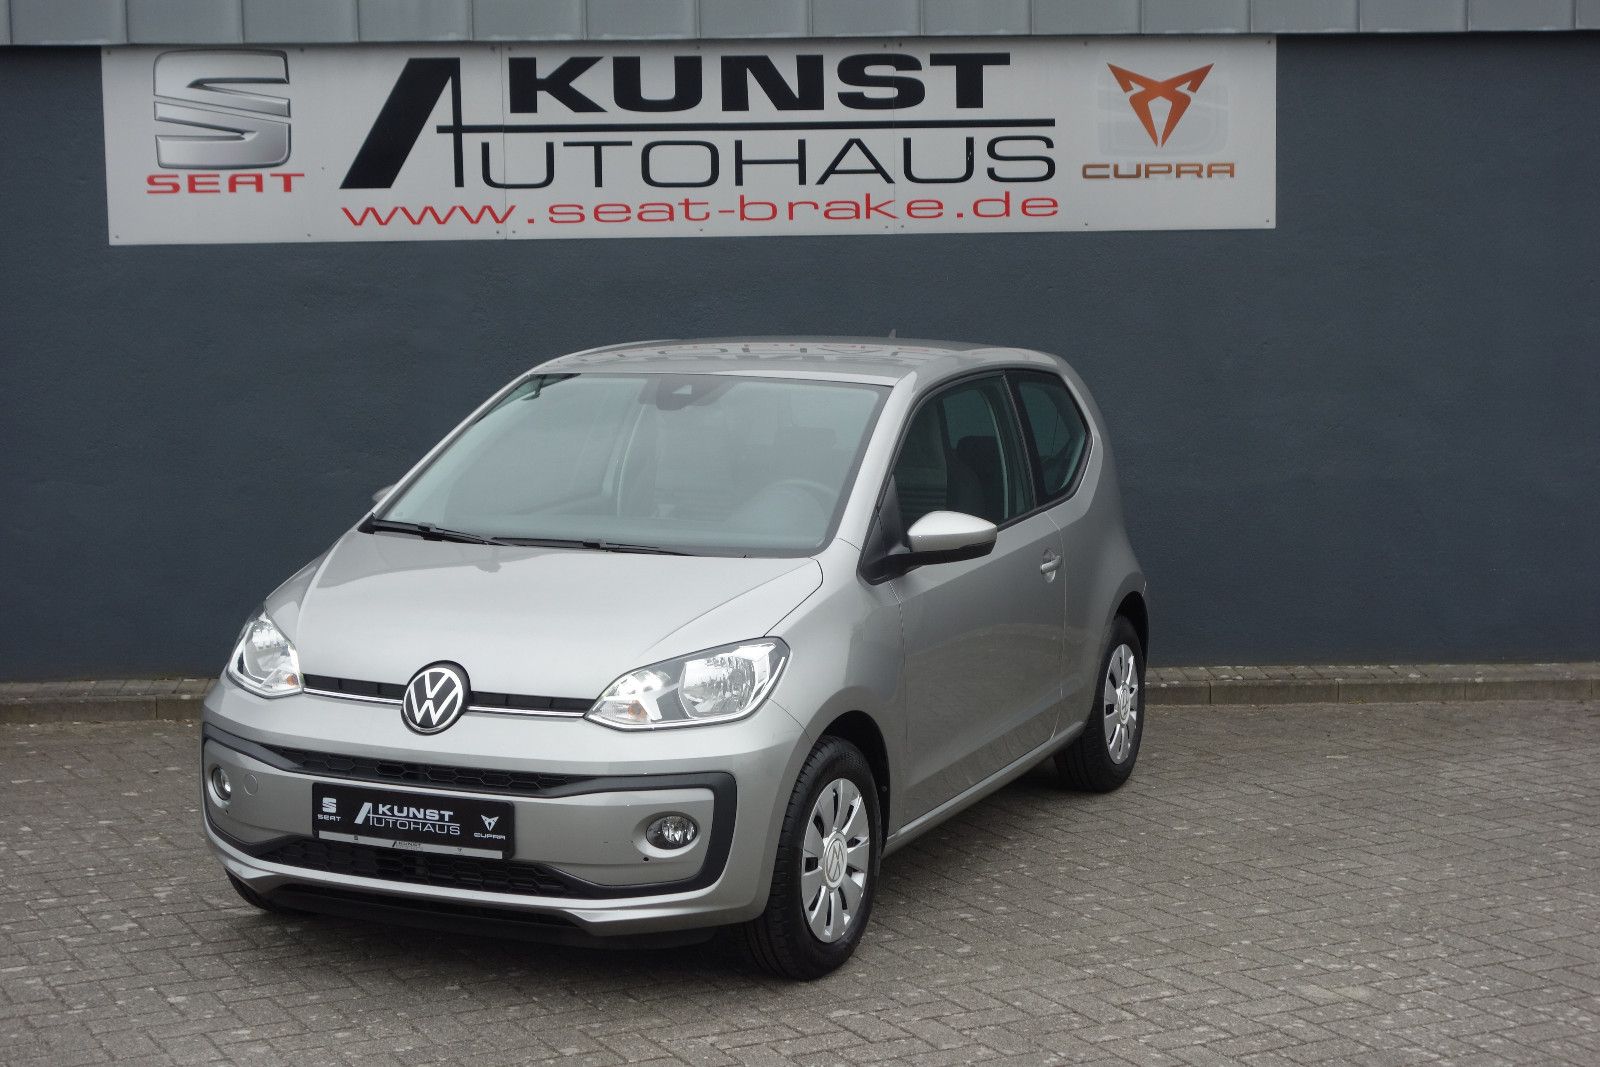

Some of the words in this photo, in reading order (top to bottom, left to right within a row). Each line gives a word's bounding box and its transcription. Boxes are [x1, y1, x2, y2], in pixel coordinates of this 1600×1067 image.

[509, 52, 1011, 113] KUNST
[339, 56, 1057, 190] AUTOHAUS
[146, 173, 306, 195] SEAT
[1081, 162, 1235, 180] CUPRA
[340, 191, 1060, 227] www.seat-brake.de
[404, 668, 463, 731] VW
[317, 813, 342, 822] SEAT
[354, 802, 461, 836] AUTOHAUS
[378, 803, 454, 822] KUNST
[473, 832, 506, 841] CUPRA
